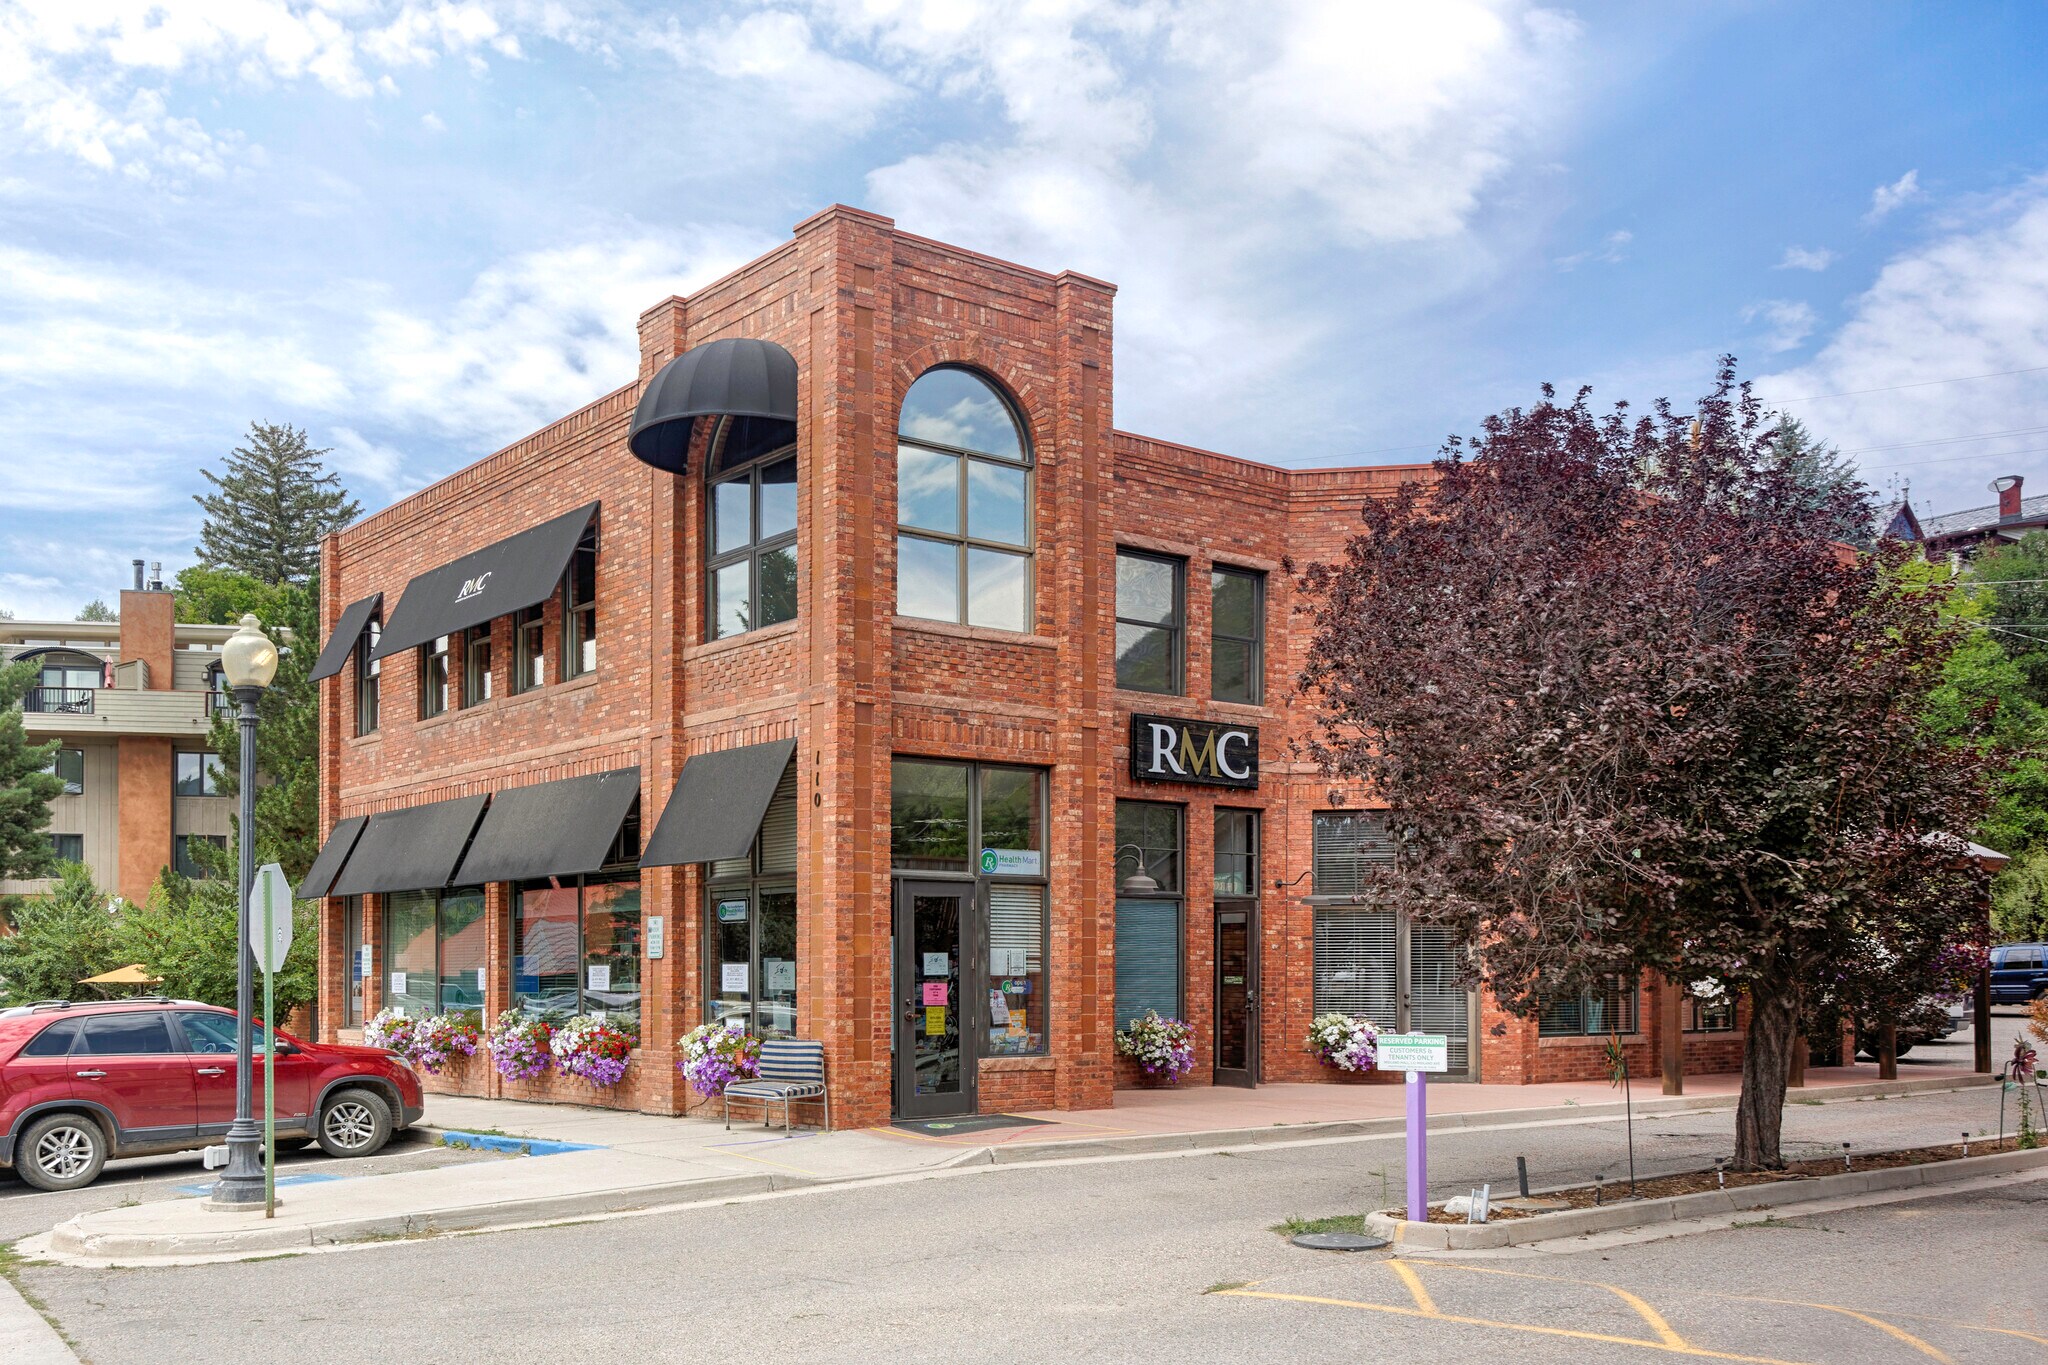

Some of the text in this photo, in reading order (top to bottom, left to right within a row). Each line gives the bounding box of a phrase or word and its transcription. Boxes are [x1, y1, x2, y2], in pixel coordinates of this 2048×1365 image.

[457, 571, 492, 598] RMC
[1147, 723, 1250, 780] RMC
[999, 855, 1021, 863] Health
